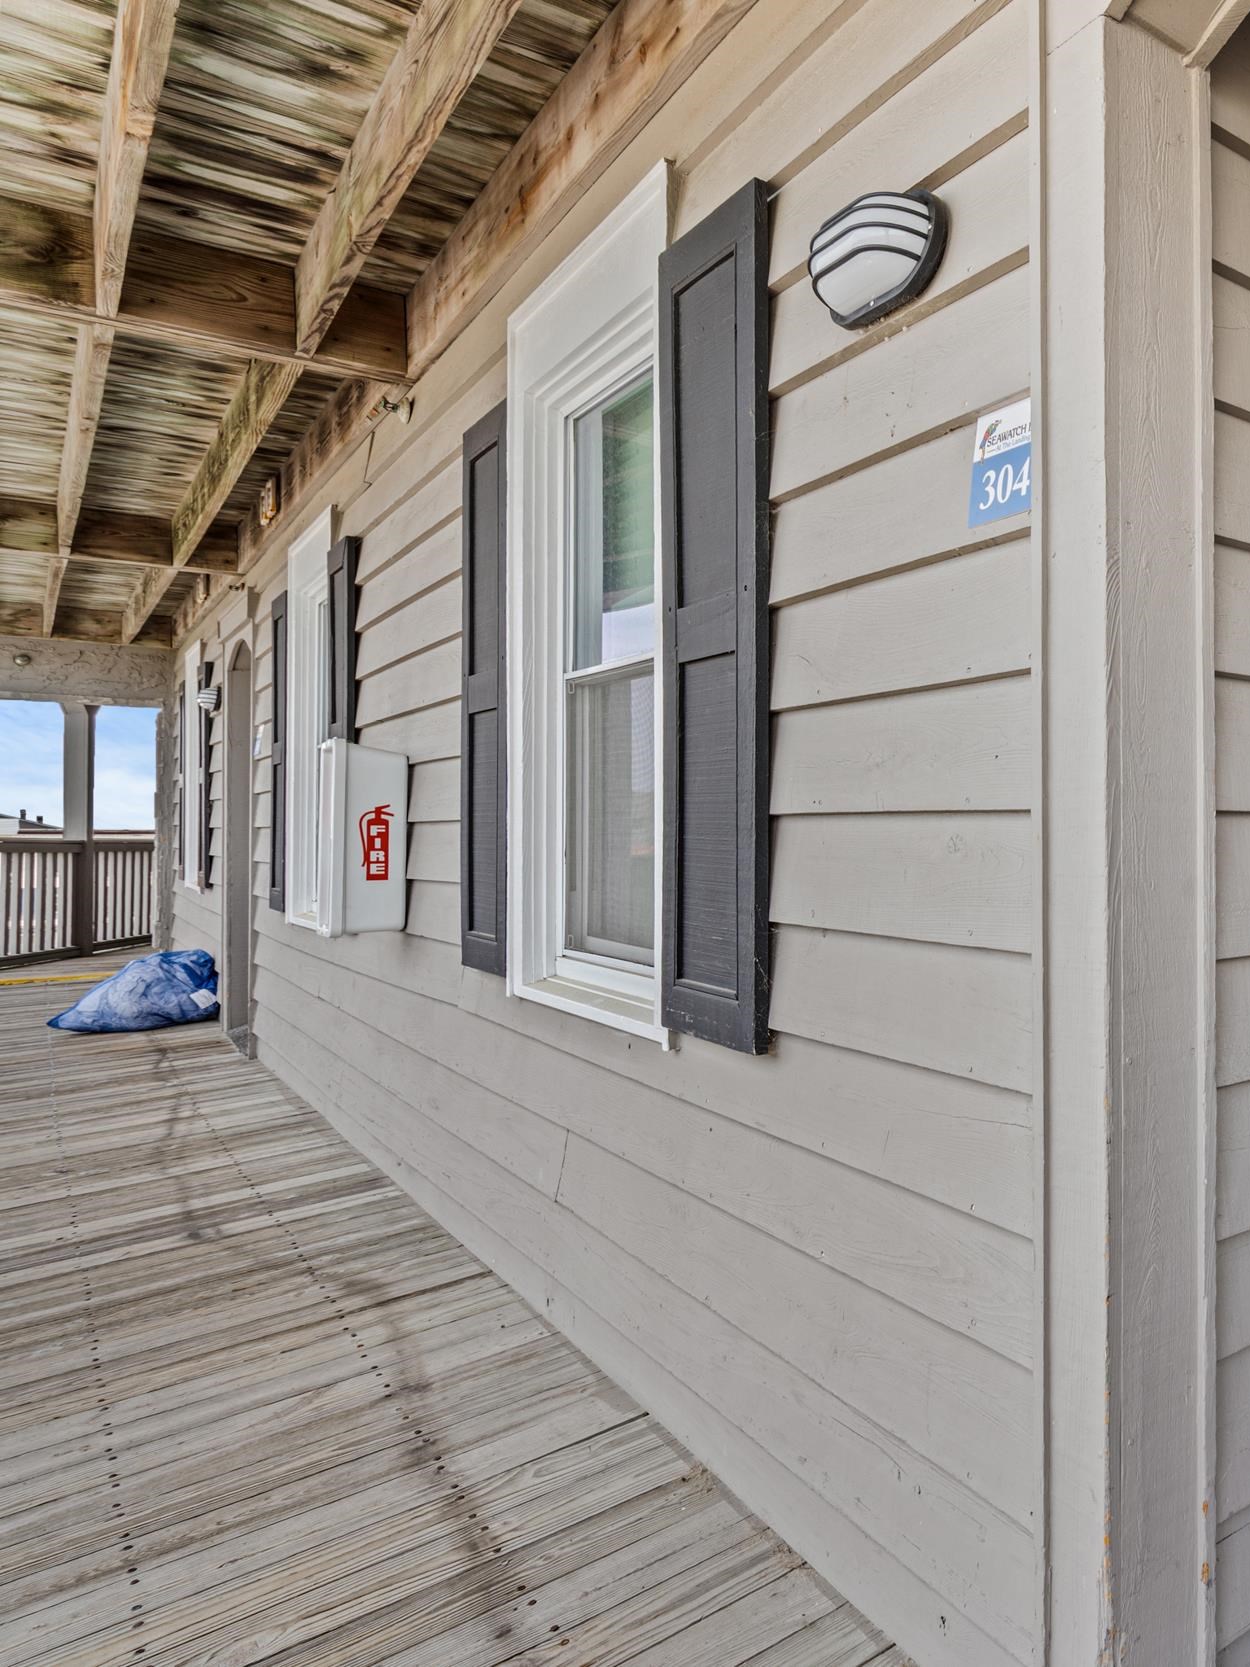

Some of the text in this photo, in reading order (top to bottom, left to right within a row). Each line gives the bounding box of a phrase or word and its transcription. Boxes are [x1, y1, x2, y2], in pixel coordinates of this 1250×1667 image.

[987, 423, 1027, 447] SEAWATCH
[978, 456, 1031, 511] 304
[369, 825, 386, 875] FIRE
